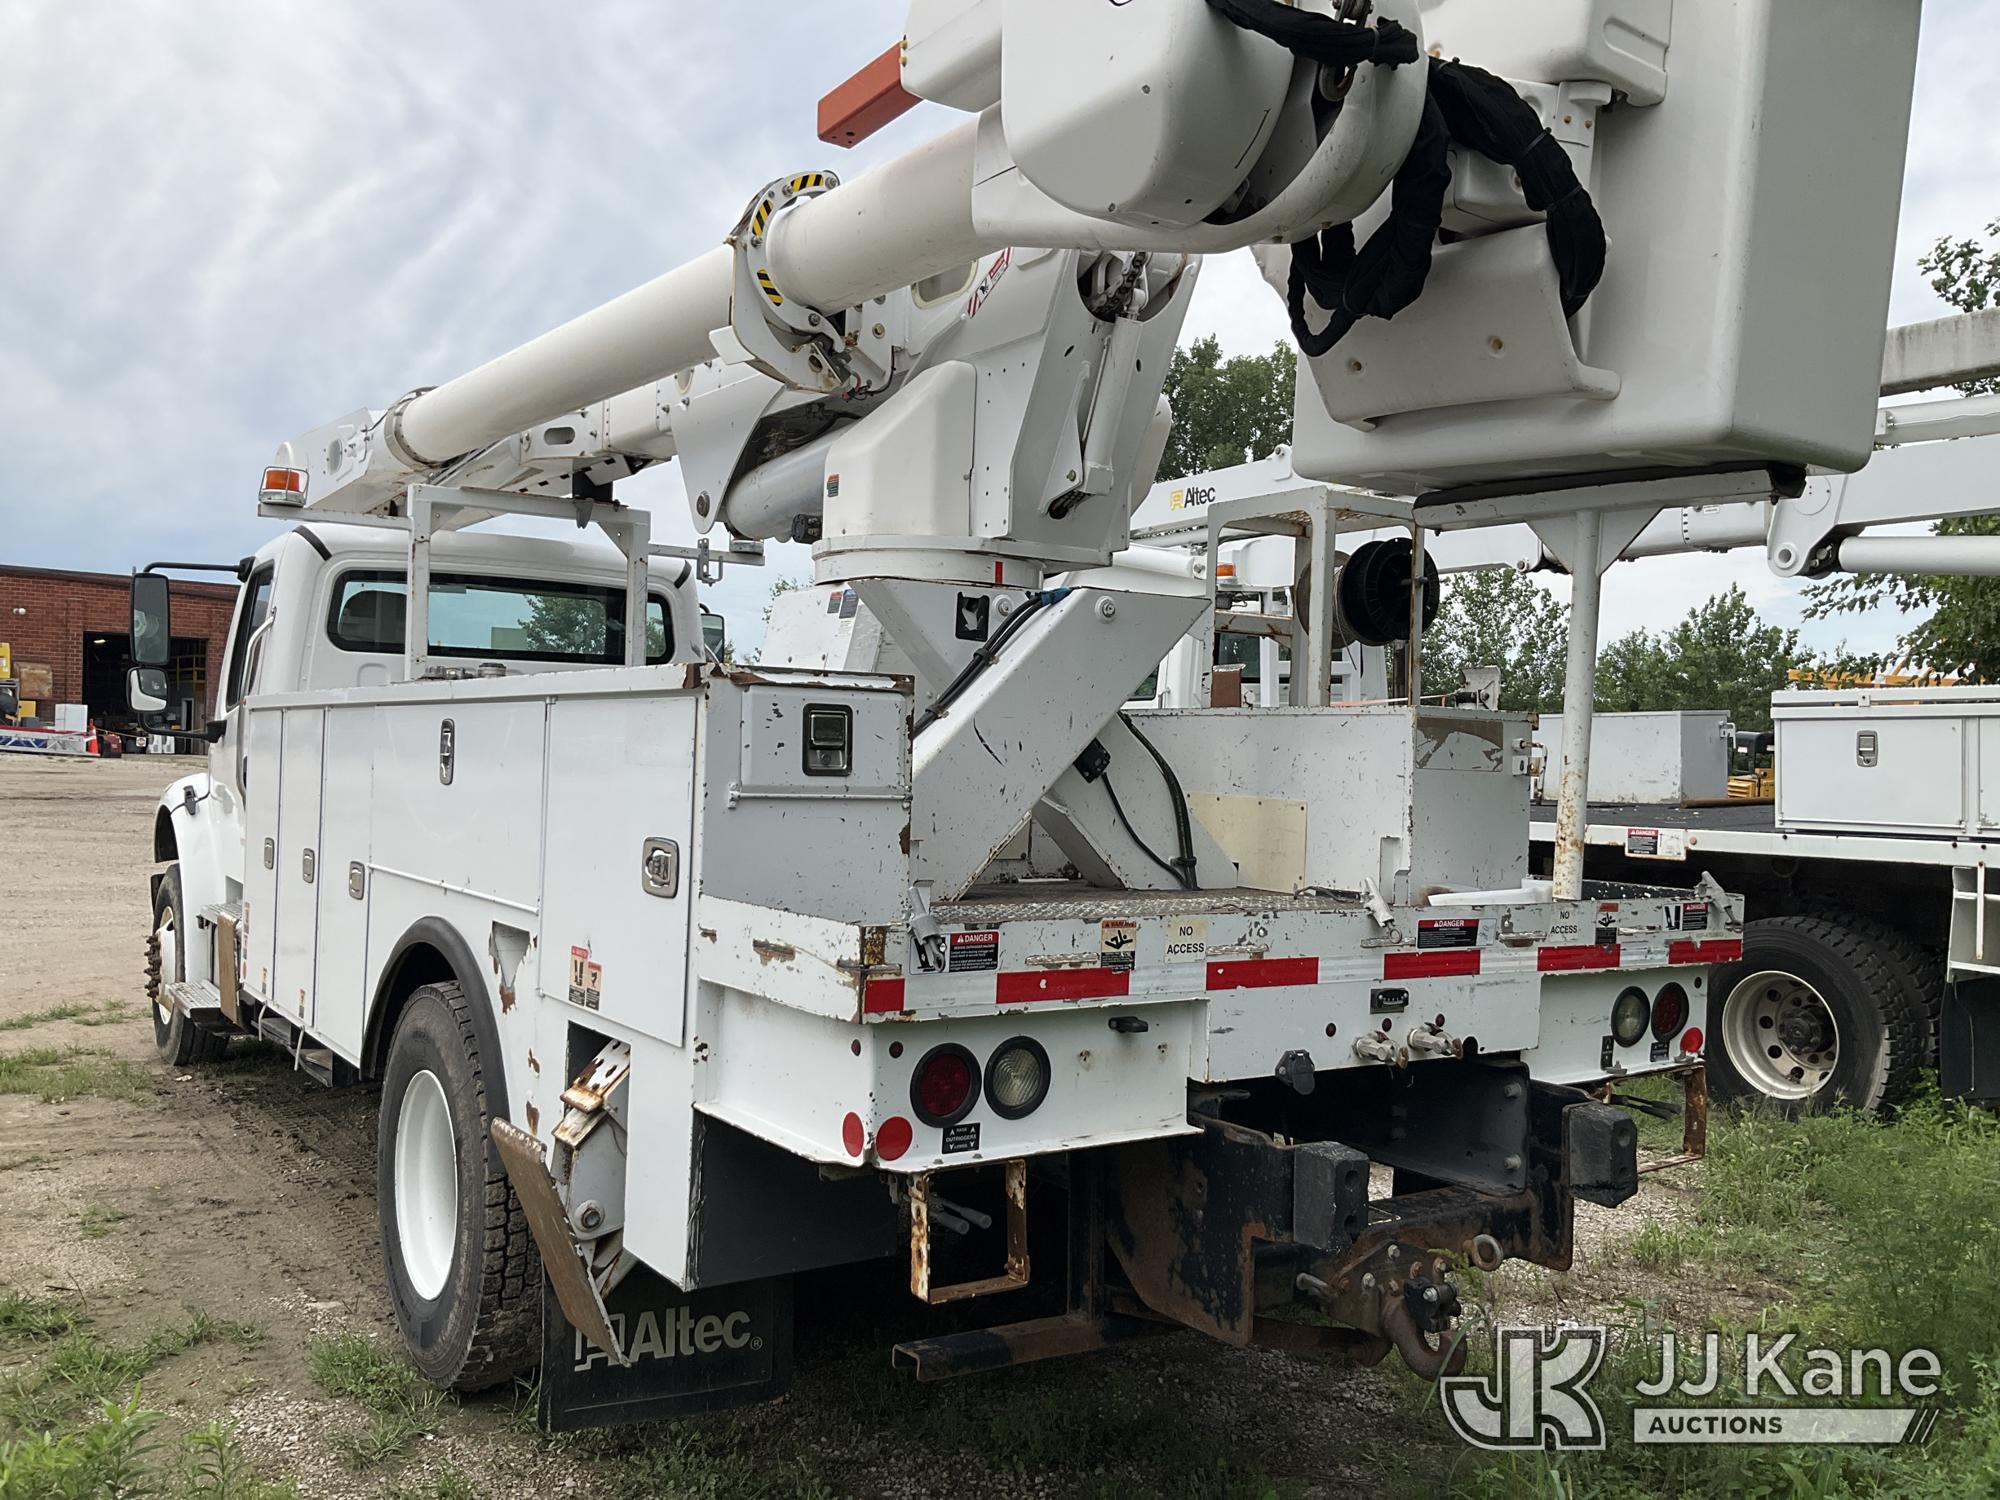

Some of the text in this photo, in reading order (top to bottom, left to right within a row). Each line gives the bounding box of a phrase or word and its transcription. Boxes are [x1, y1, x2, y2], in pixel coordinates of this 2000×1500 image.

[1184, 487, 1216, 508] Altec
[1560, 911, 1570, 919] NO
[1179, 926, 1194, 937] NO
[1550, 925, 1578, 934] ACCESS
[964, 933, 993, 943] DANGER
[1167, 942, 1205, 954] ACCESS
